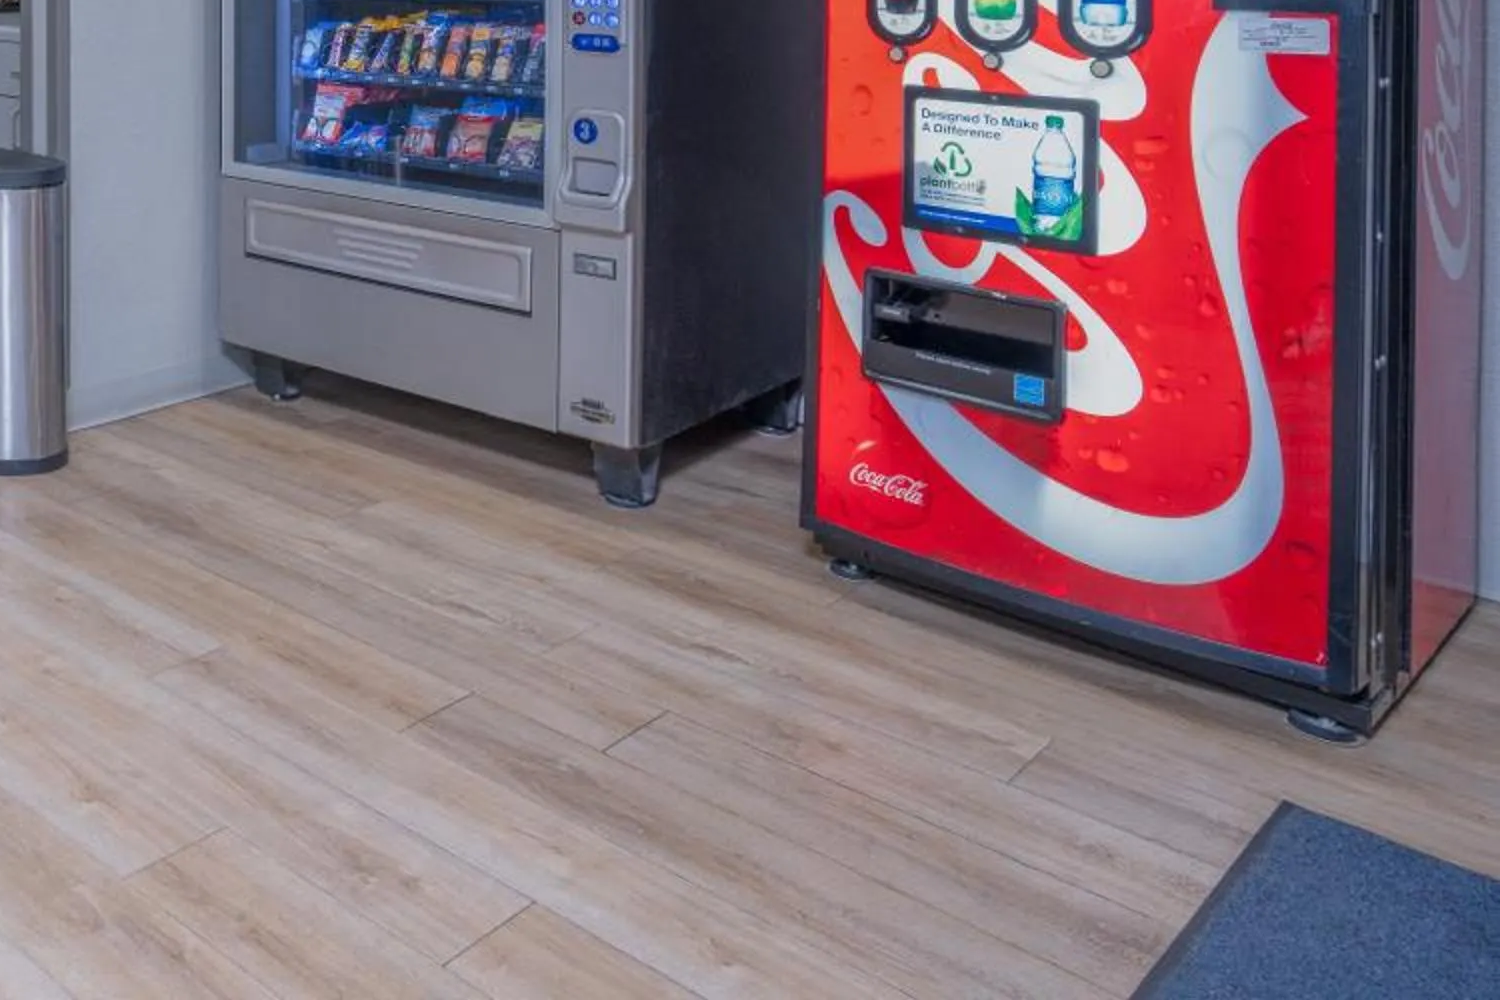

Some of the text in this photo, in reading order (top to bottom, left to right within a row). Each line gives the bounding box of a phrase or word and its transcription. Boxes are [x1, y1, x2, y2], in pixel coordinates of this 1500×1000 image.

[921, 107, 1039, 131] Designed To Make
[922, 122, 1001, 141] A Difference
